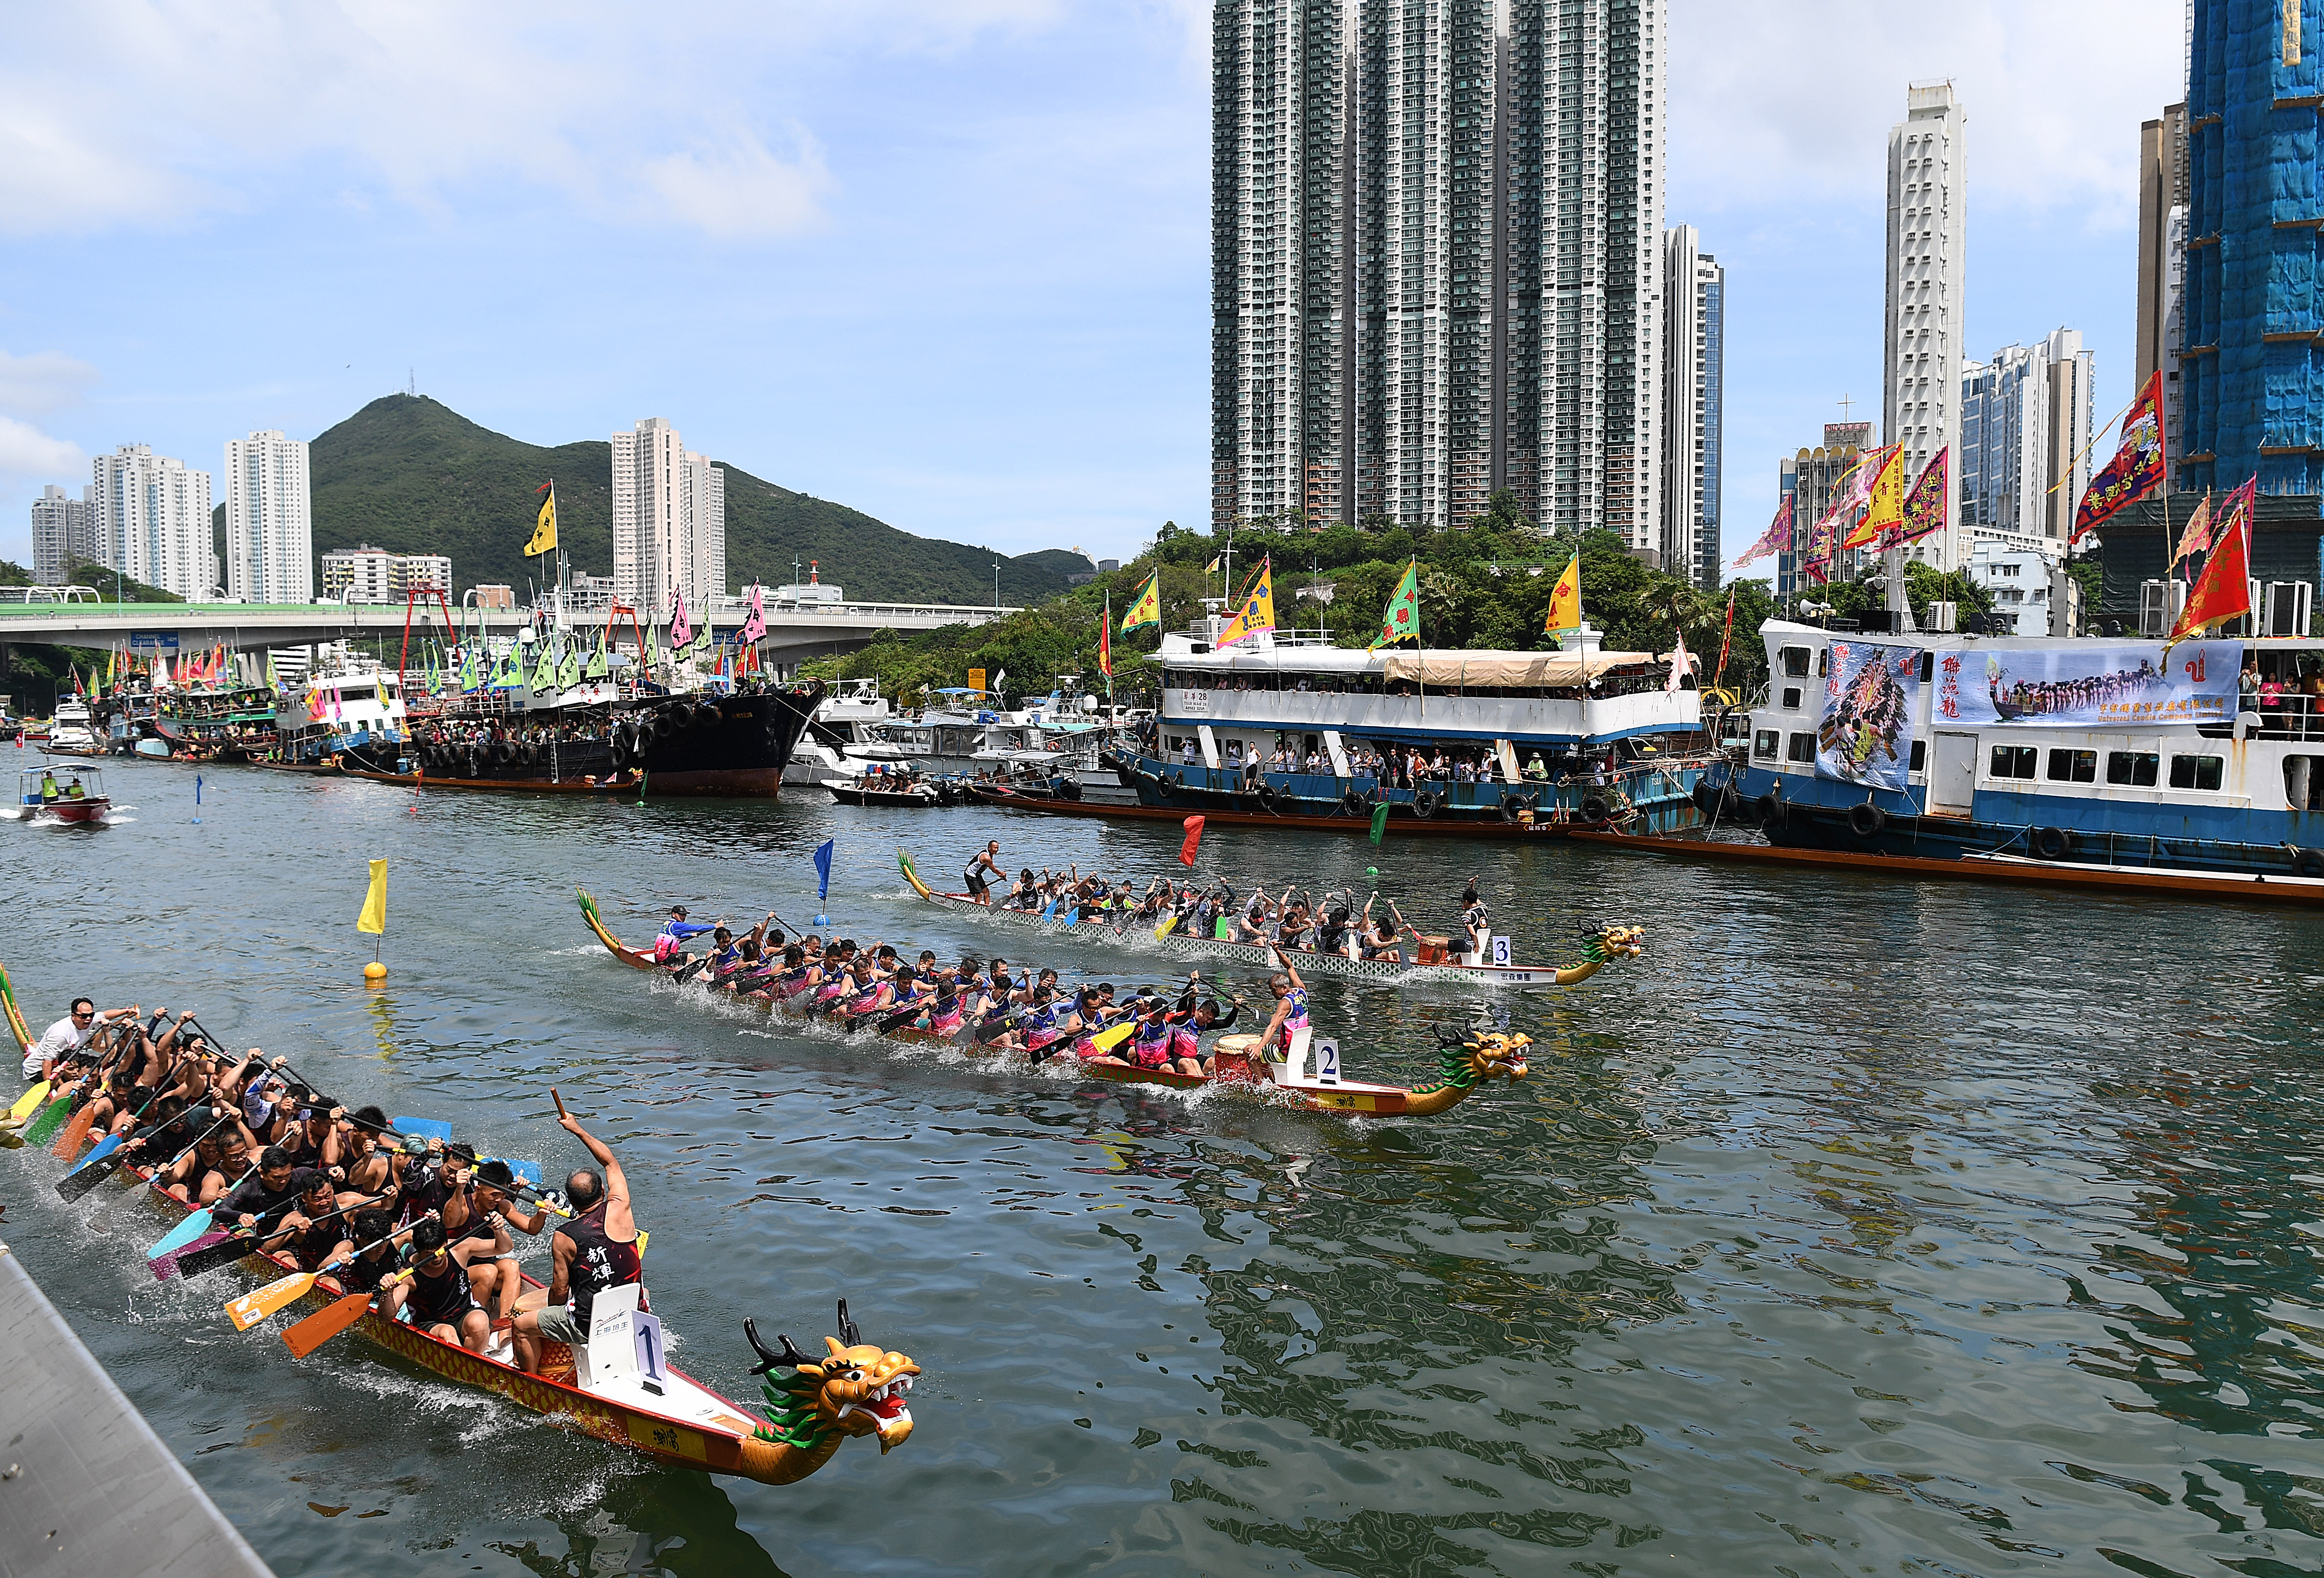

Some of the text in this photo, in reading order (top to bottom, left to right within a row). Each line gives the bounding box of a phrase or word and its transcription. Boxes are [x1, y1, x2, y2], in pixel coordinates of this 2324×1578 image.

[1937, 655, 1961, 719] 聯漁龍
[1496, 940, 1508, 962] 3
[1321, 1045, 1337, 1075] 2
[586, 1246, 615, 1292] 新輝
[595, 1321, 628, 1336] 上海培生
[638, 1324, 662, 1381] 1
